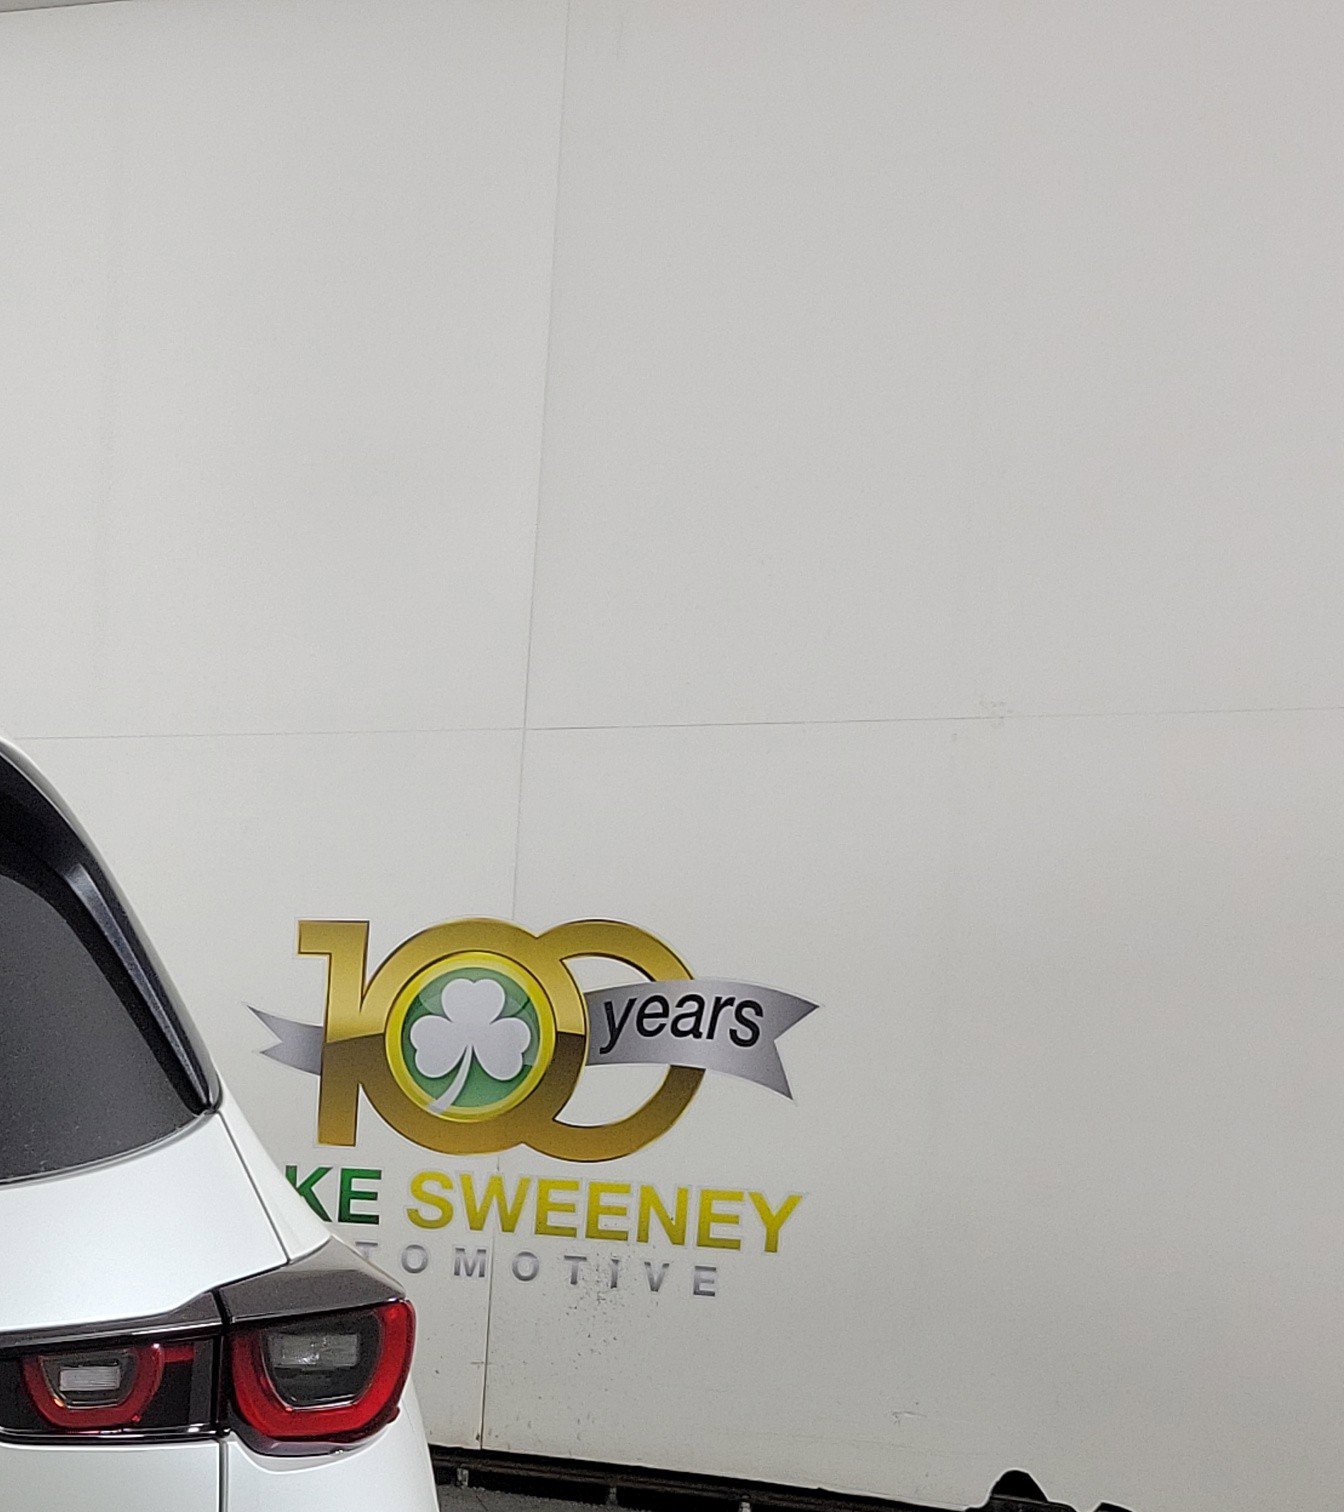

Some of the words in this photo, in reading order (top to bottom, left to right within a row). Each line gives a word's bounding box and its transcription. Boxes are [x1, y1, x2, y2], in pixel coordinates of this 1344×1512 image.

[297, 917, 707, 1163] 100
[598, 992, 765, 1055] years
[285, 1165, 383, 1225] KE
[405, 1171, 805, 1253] SWEENEY
